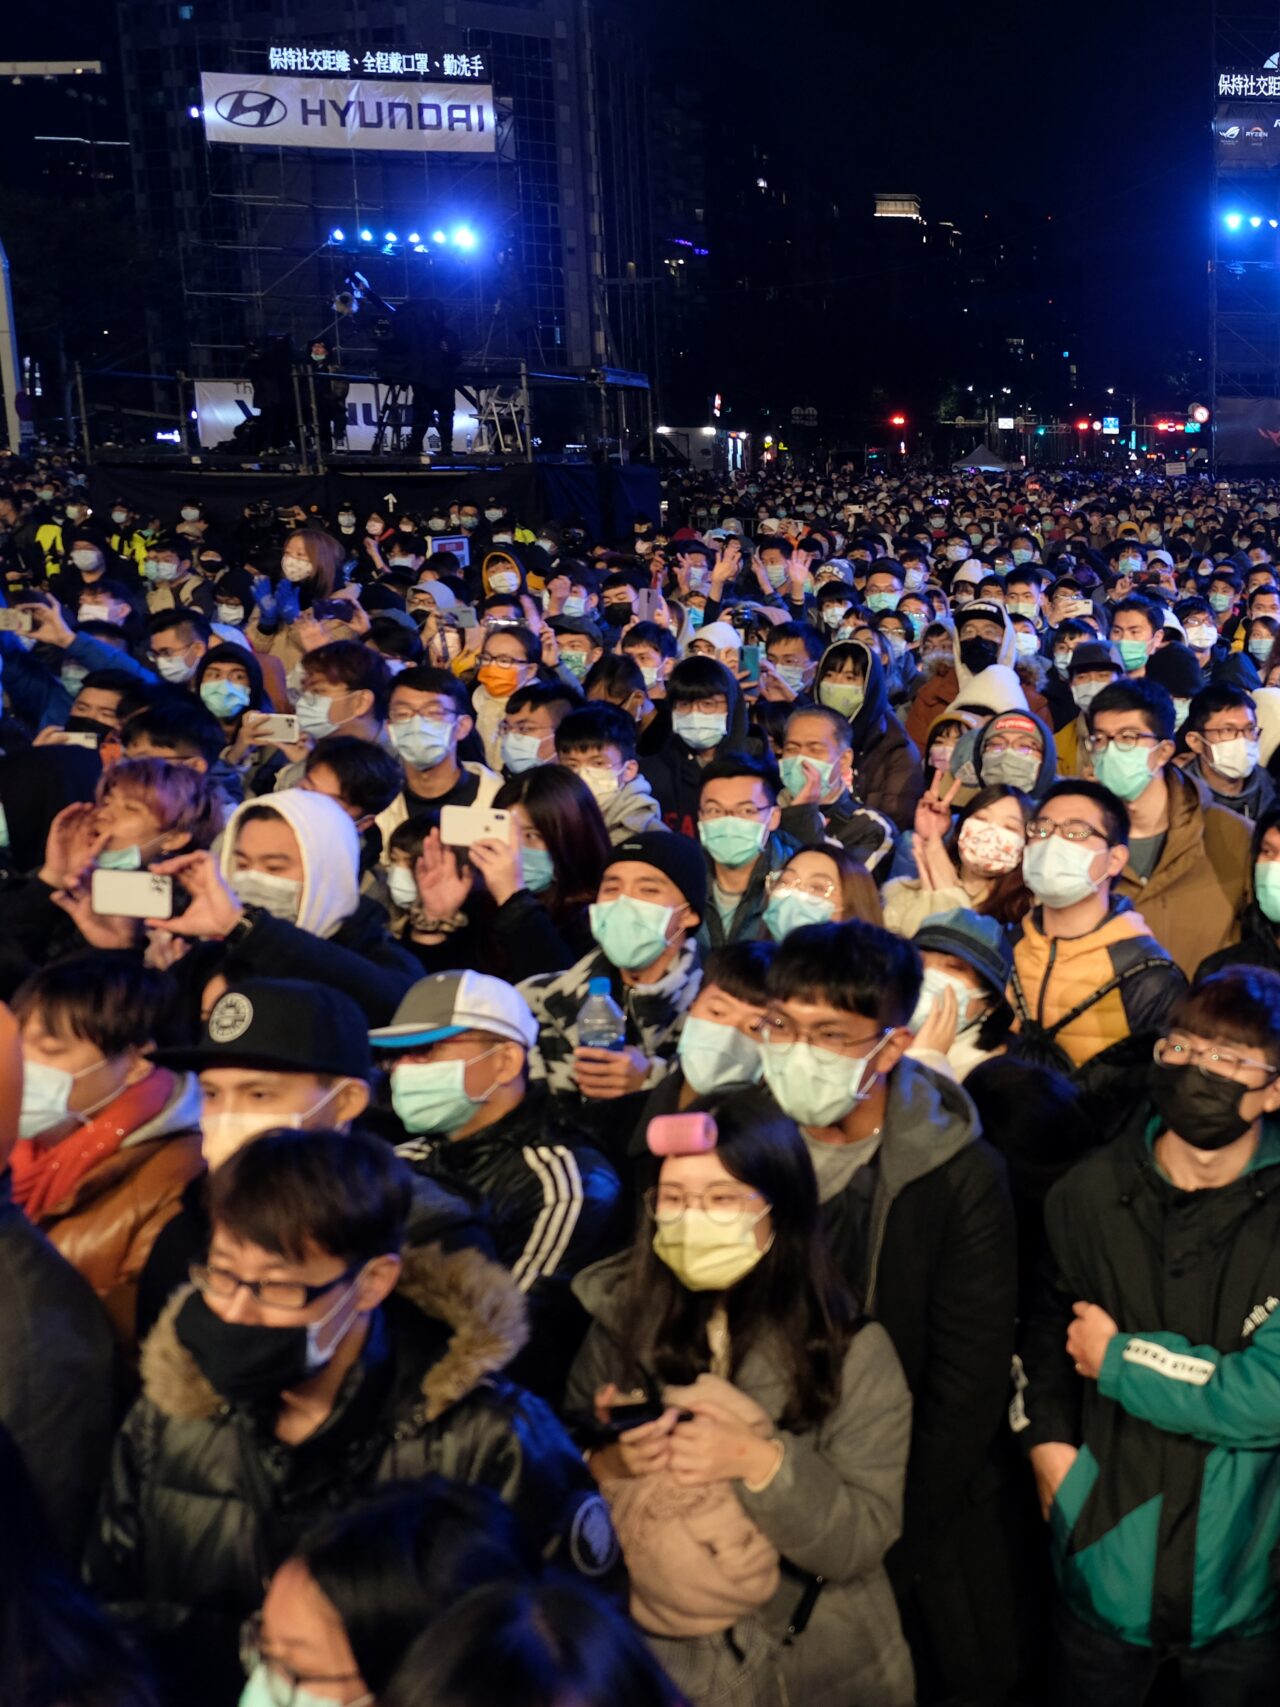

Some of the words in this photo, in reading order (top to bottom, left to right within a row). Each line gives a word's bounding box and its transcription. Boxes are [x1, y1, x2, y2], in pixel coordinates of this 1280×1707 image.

[269, 47, 484, 77] 保持社交距離、全程戴口罩、勤洗手
[301, 98, 485, 132] HYUNDAI
